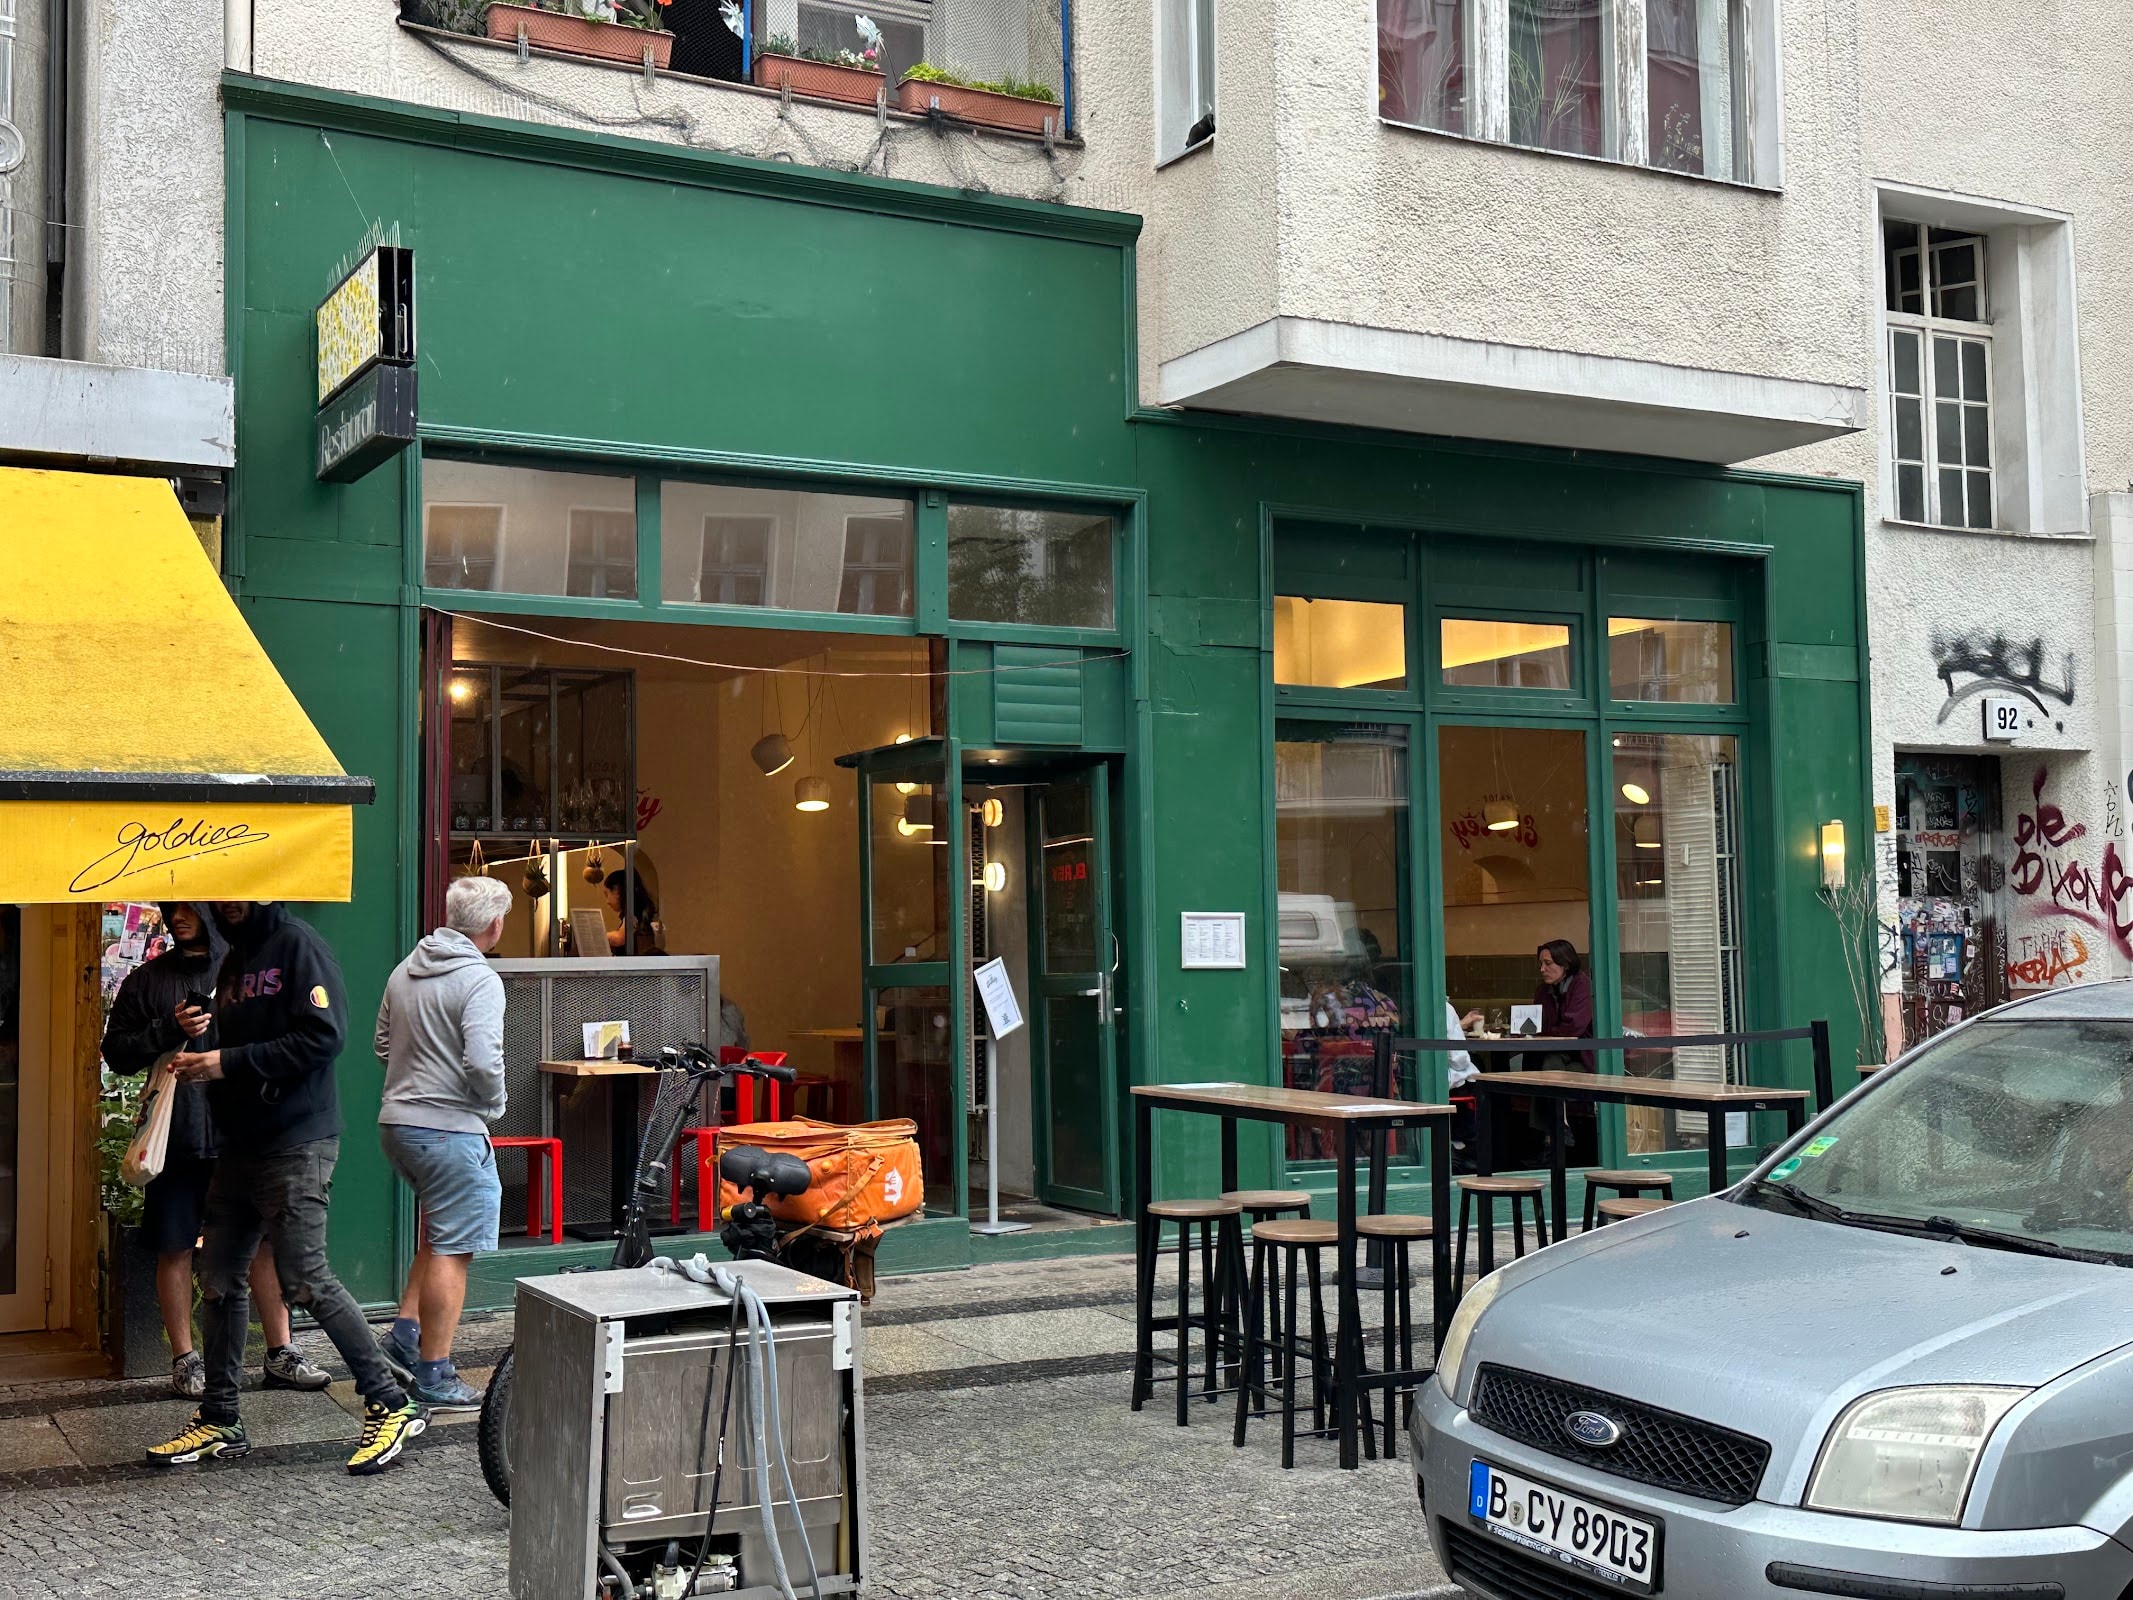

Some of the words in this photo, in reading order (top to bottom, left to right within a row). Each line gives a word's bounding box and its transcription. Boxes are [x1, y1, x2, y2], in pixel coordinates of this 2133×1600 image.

[1997, 707, 2018, 730] 92
[1573, 1416, 1604, 1437] Ford
[1476, 1495, 1483, 1508] D
[1489, 1474, 1507, 1518] B
[1527, 1489, 1564, 1541] CY
[1571, 1506, 1649, 1574] 8903
